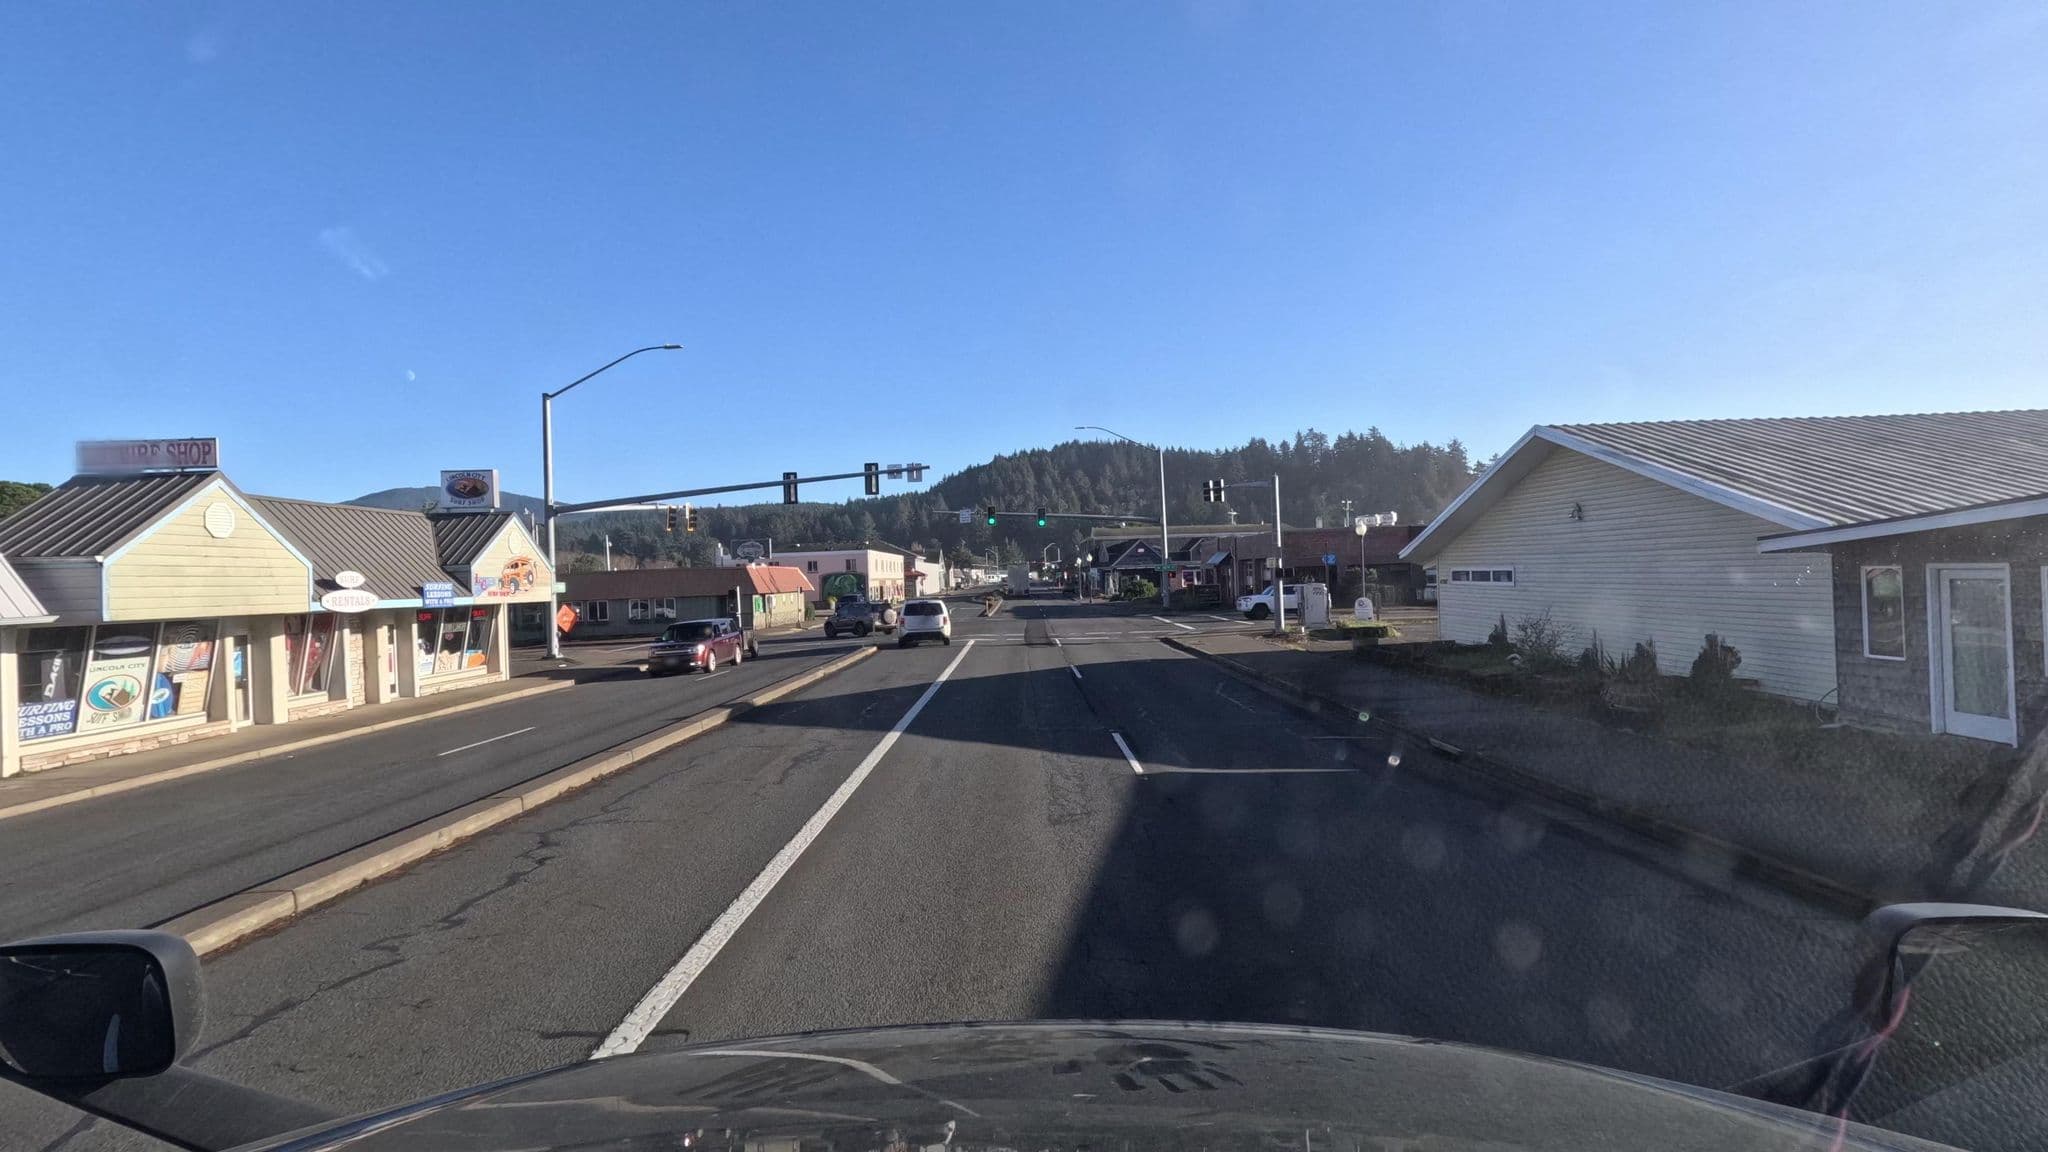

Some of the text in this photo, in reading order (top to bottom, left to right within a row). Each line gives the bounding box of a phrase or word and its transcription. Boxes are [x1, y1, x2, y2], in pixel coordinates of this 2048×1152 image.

[166, 442, 212, 465] SHOP
[331, 595, 370, 608] RENTALS
[89, 662, 146, 673] LINCOLN CITY
[19, 700, 76, 717] URFING
[19, 712, 71, 728] ESSONS
[38, 725, 47, 735] A
[49, 721, 73, 734] PRO
